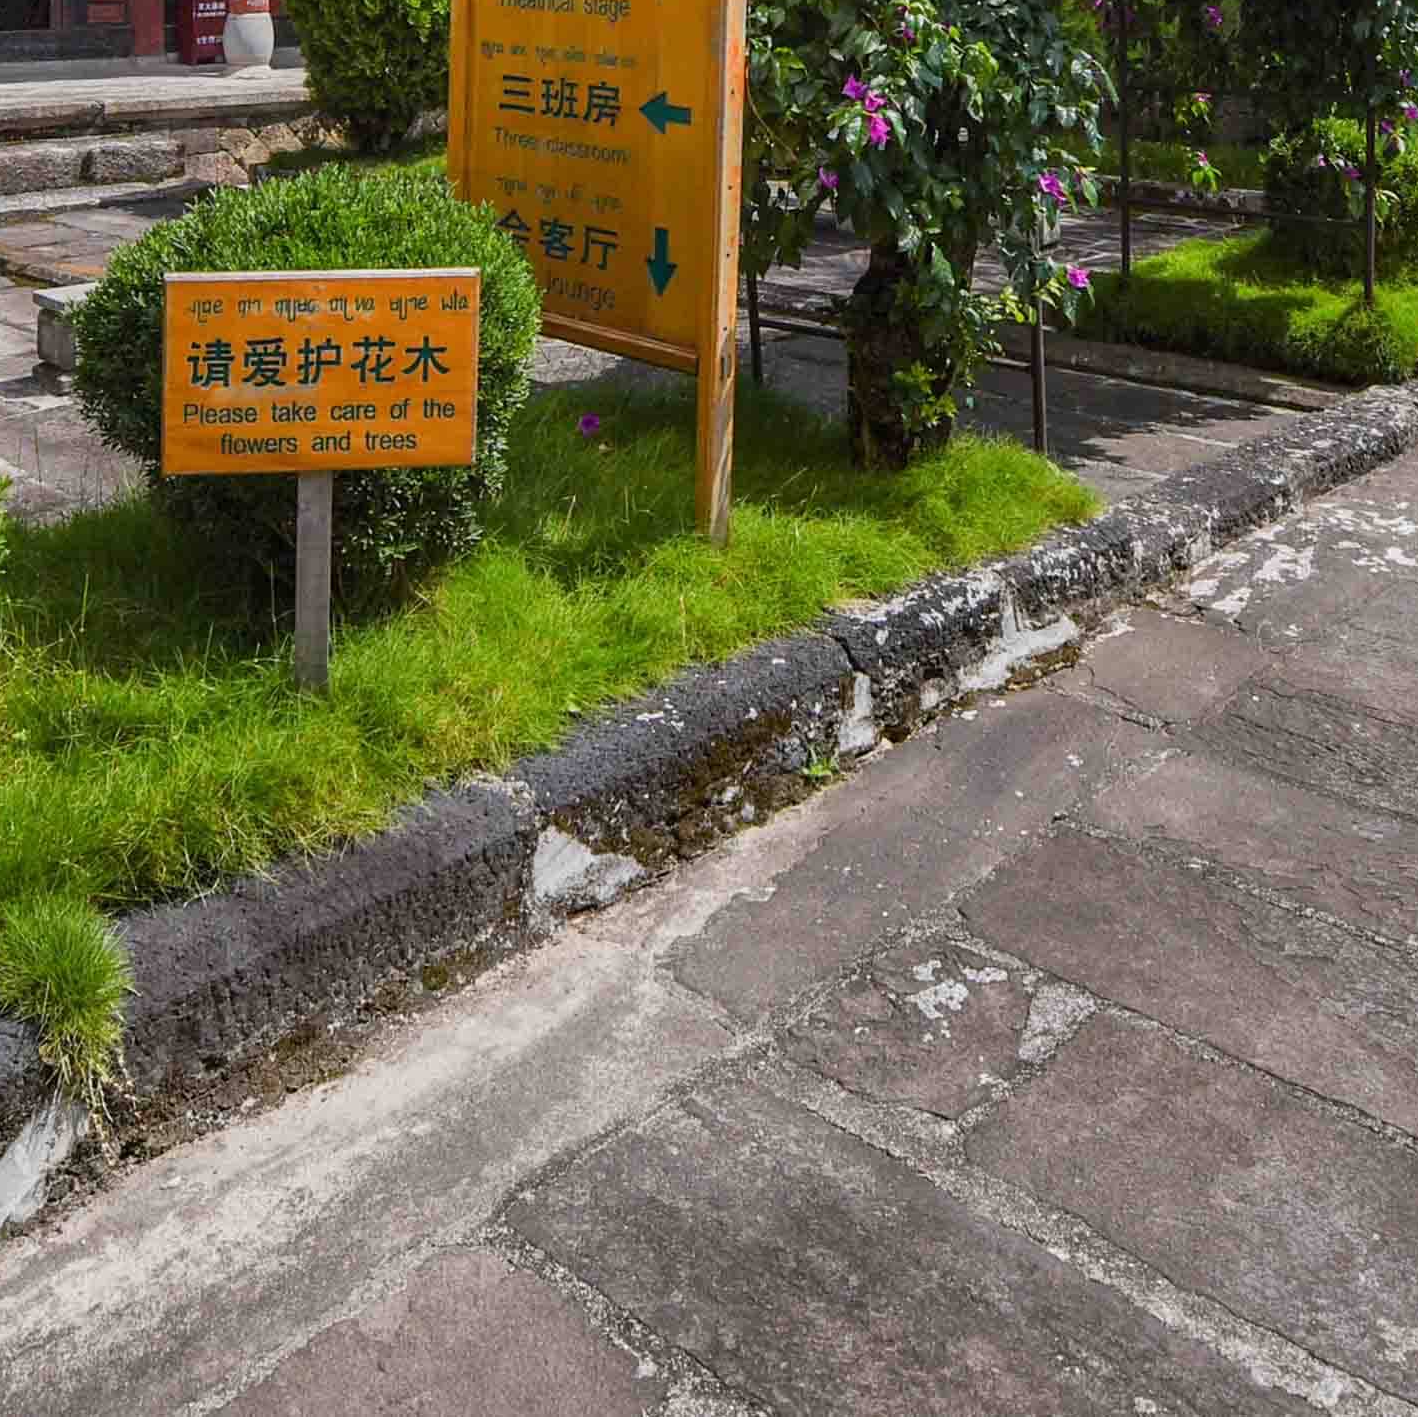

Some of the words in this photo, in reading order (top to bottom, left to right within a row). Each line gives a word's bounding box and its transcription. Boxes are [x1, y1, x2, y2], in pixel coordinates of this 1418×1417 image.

[499, 74, 622, 126] 三班房
[495, 126, 535, 150] Three
[495, 209, 618, 270] 会客厅
[187, 335, 450, 388] 请爱护花木
[183, 403, 258, 425] Please
[272, 401, 316, 423] take
[330, 404, 376, 422] care
[390, 399, 412, 421] of
[423, 399, 456, 419] the
[220, 433, 298, 455] flowers
[311, 431, 351, 452] and
[365, 431, 418, 451] trees
